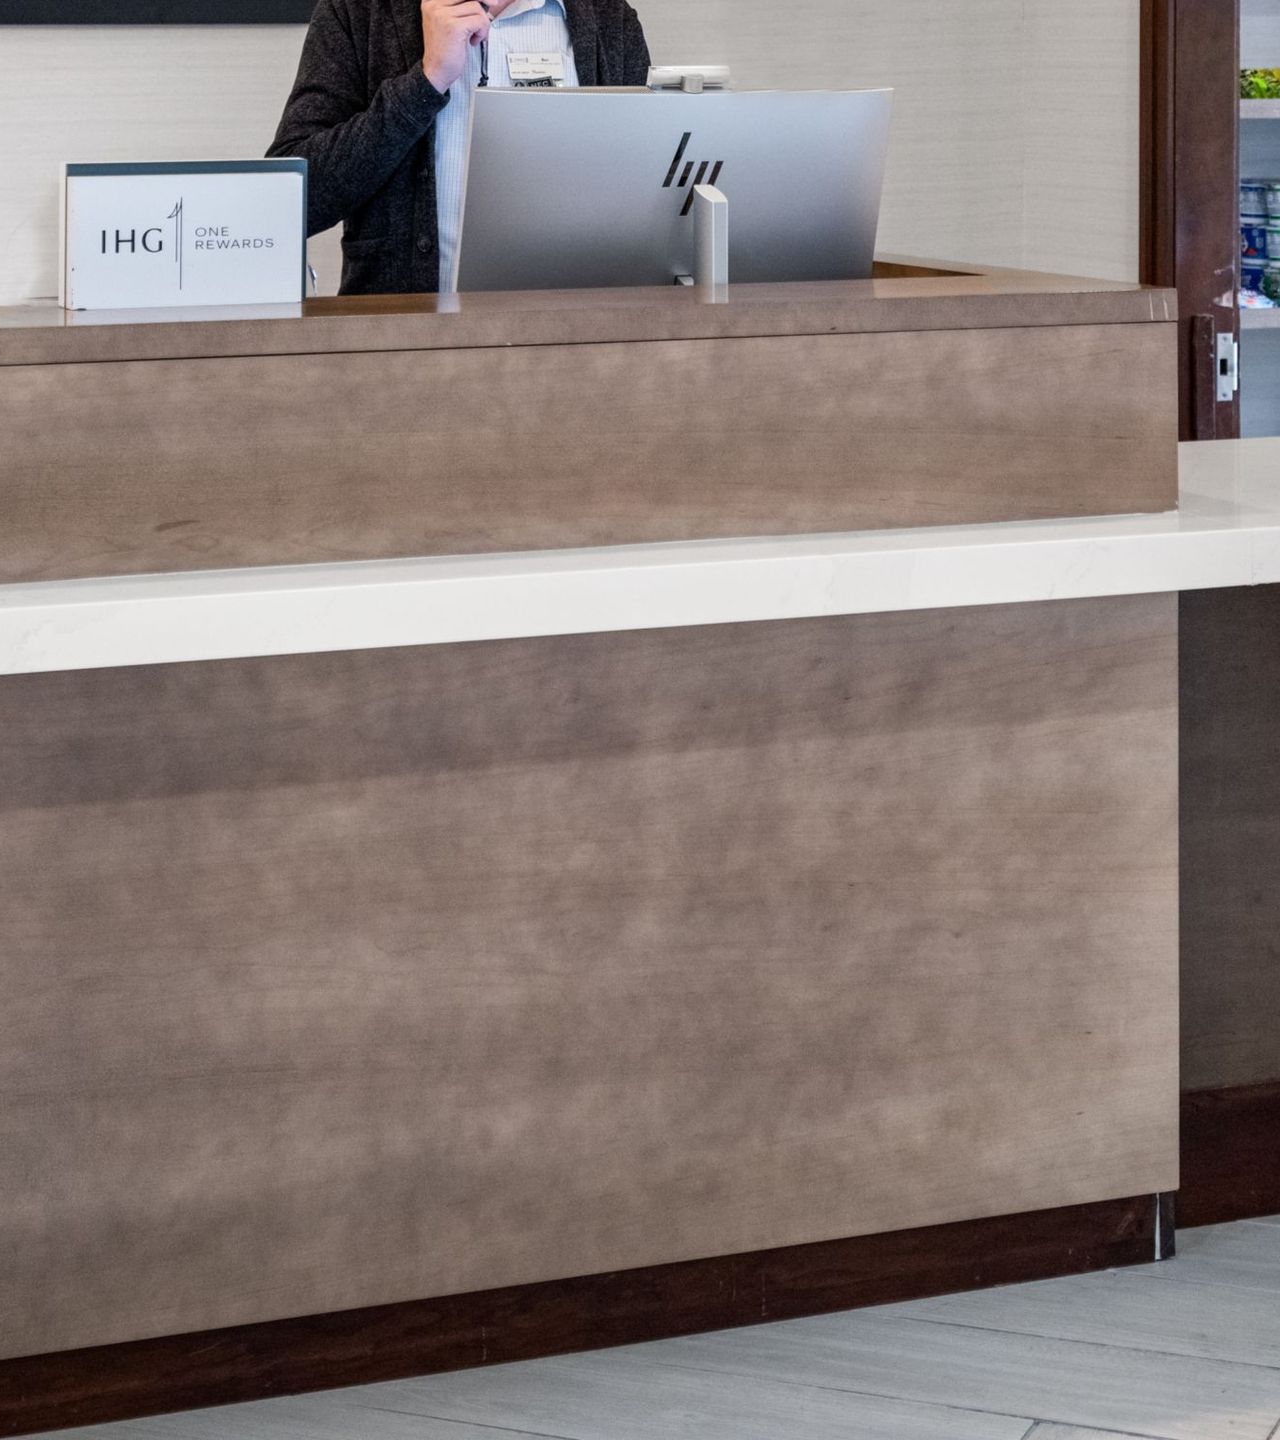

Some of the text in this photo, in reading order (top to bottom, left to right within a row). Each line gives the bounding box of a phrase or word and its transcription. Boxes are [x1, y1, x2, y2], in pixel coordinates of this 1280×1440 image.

[195, 226, 230, 238] ONE
[101, 227, 164, 254] IHG
[195, 238, 275, 250] REWARDS
